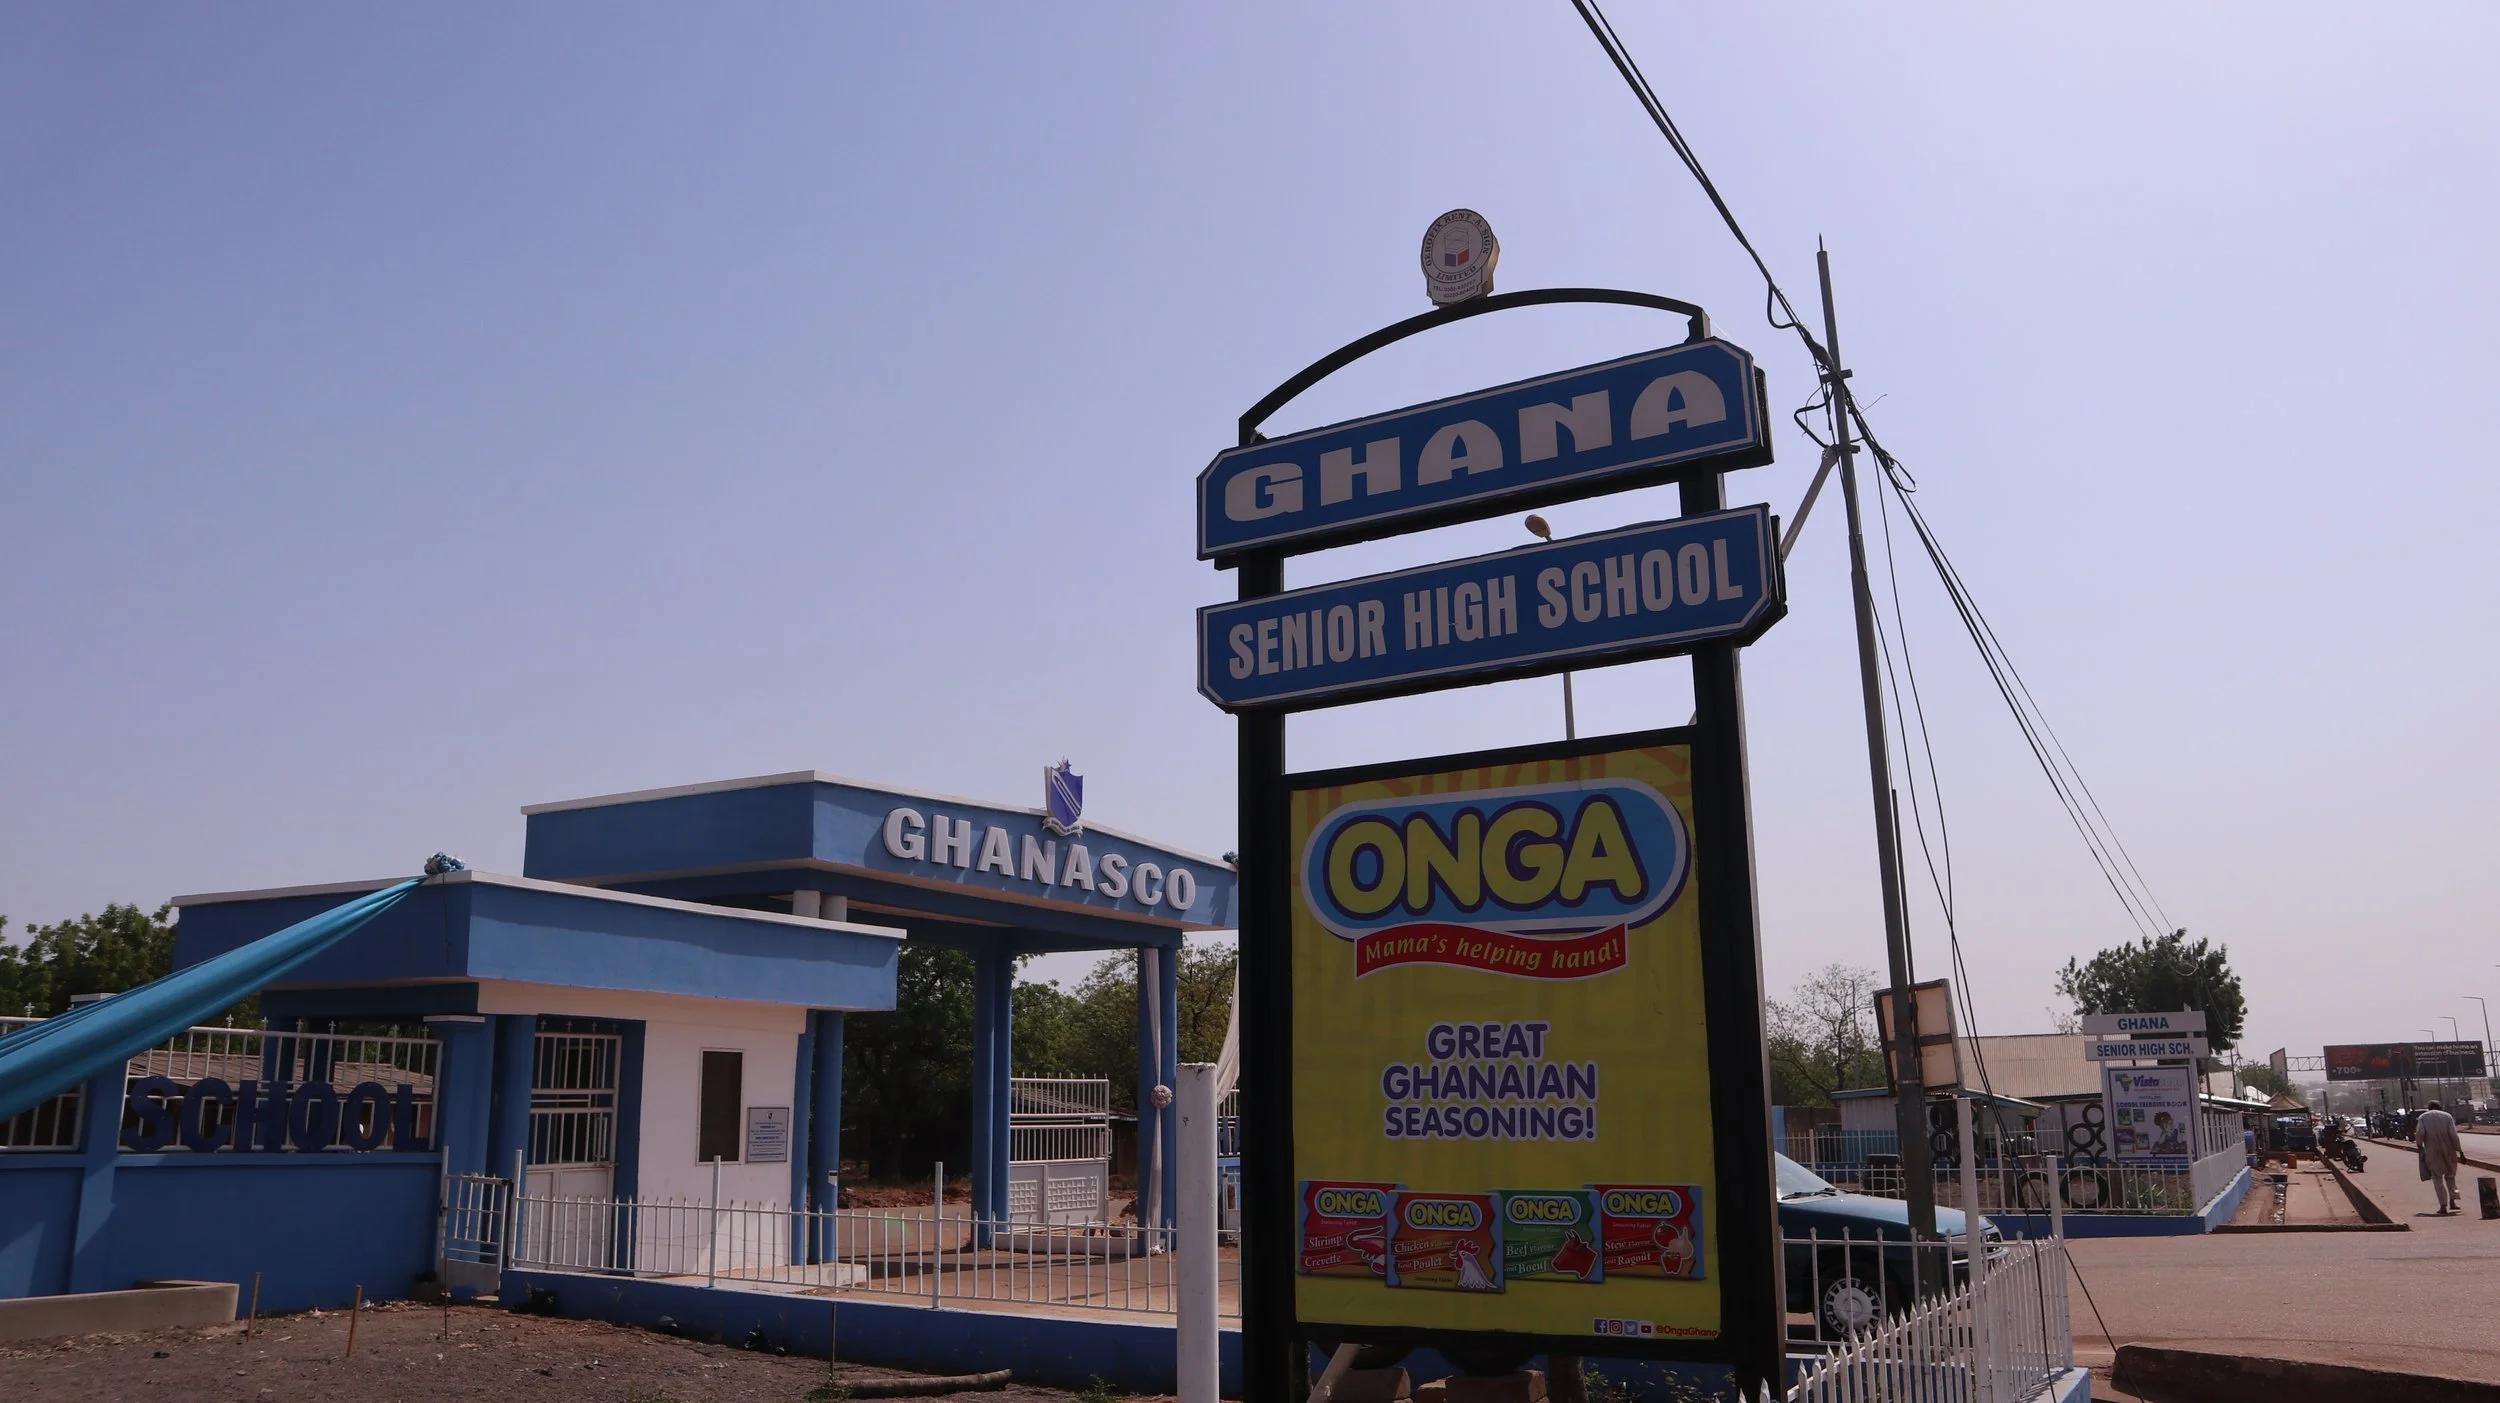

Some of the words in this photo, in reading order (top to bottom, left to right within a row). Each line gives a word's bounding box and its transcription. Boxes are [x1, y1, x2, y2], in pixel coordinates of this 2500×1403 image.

[1444, 212, 1472, 223] RENT
[1482, 229, 1491, 254] SIGN
[1436, 266, 1477, 281] LIMITED
[1224, 370, 1727, 521] GHANA
[1229, 599, 1386, 679] SENIOR
[1403, 574, 1518, 651] HIGH
[1537, 538, 1743, 629] SCHOOL
[883, 807, 1196, 911] GHANASCO
[1326, 797, 1645, 917] ONGA
[1365, 934, 1447, 964] Mama's
[1456, 937, 1541, 971] helping
[1551, 938, 1620, 970] hand!
[2117, 1016, 2170, 1031] GHANA
[1427, 1023, 1548, 1060] GREAT
[2096, 1044, 2136, 1057] SENIOR
[2141, 1043, 2166, 1056] HIGH
[2168, 1042, 2194, 1055] SCH.
[1382, 1063, 1596, 1101] GHANAIAN
[121, 1075, 429, 1152] SCHOOL
[1385, 1105, 1595, 1140] SEASONING!
[1319, 1190, 1382, 1215] ONGA
[1410, 1202, 1476, 1227] ONGA
[1511, 1198, 1575, 1221] ONGA
[1607, 1192, 1674, 1214] ONGA
[1309, 1235, 1342, 1249] Shrimp
[1394, 1240, 1430, 1253] Chicken
[1506, 1242, 1529, 1256] Beef
[1604, 1239, 1626, 1251] Stew
[1305, 1254, 1342, 1267] Crevette
[1413, 1256, 1443, 1270] Poulet
